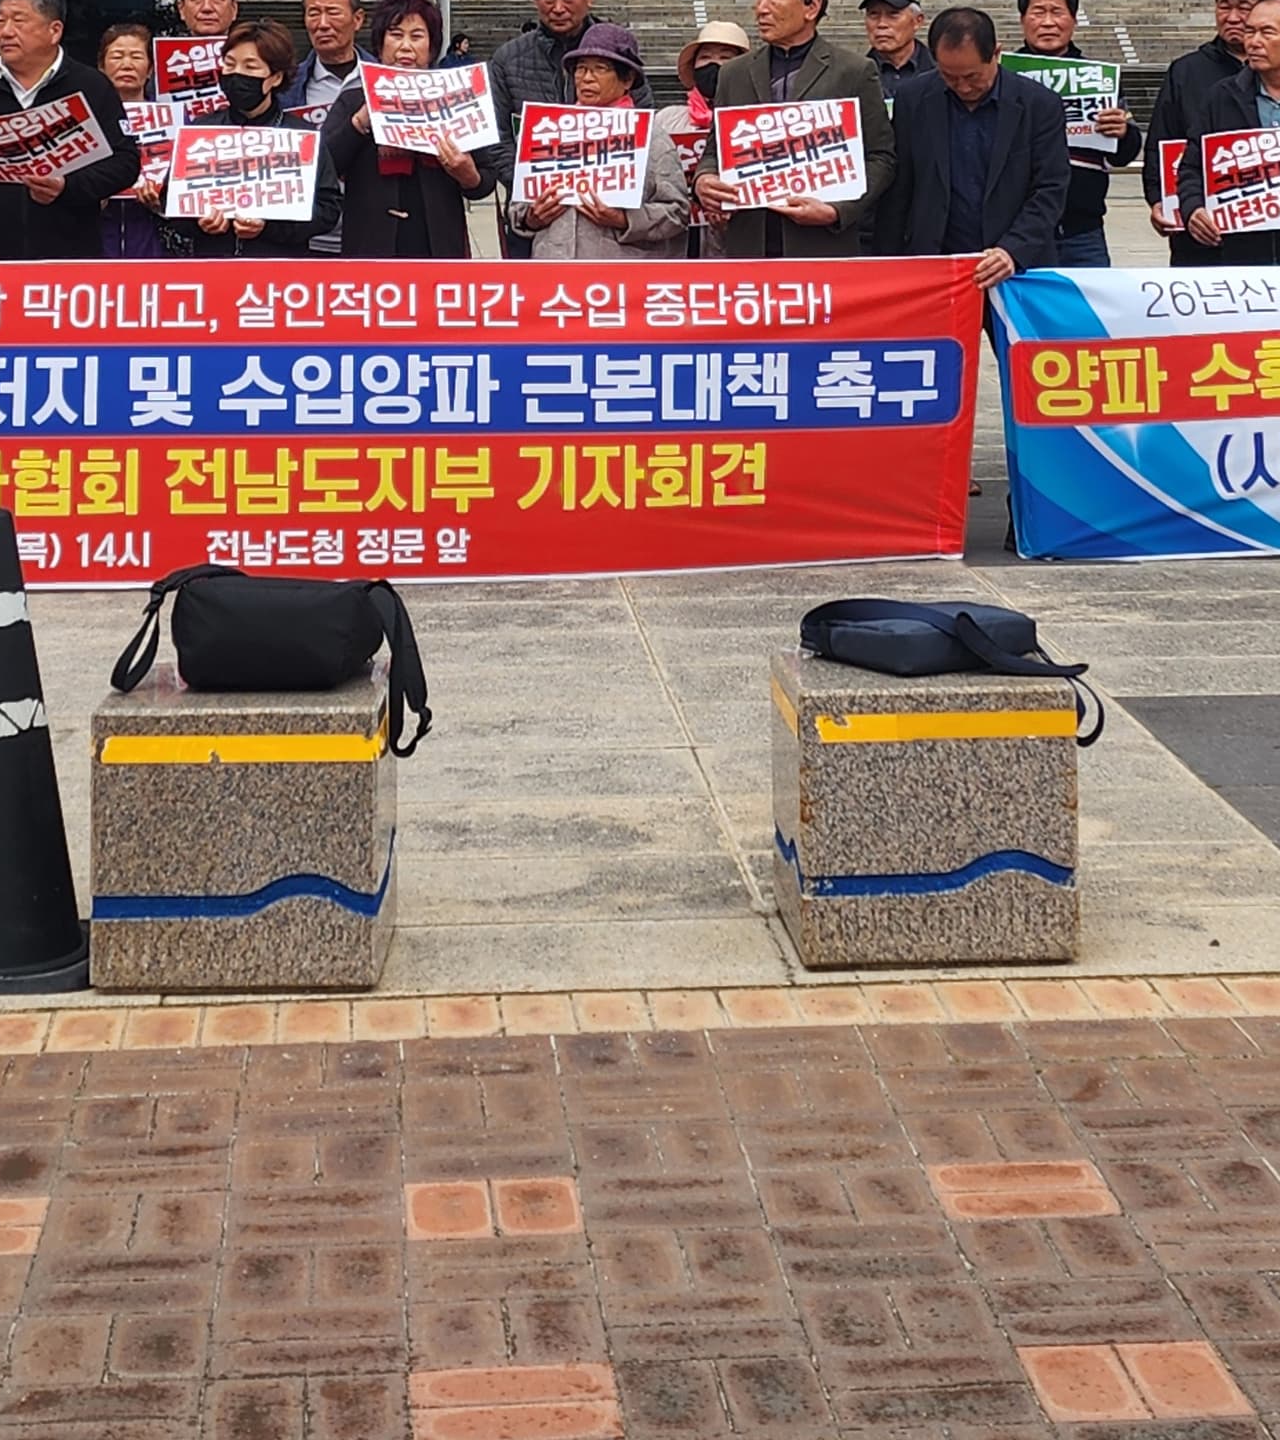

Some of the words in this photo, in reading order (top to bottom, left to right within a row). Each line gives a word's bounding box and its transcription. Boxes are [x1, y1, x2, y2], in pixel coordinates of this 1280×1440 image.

[374, 68, 473, 100] 수입양파
[186, 131, 304, 164] 수입양파
[532, 110, 639, 145] 수입양파
[730, 102, 843, 149] 수입양파
[178, 179, 305, 215] 마련하라!
[733, 154, 857, 206] 마련하라!
[23, 283, 218, 333] 막아내고,
[235, 283, 419, 329] 살인적인
[435, 282, 524, 329] 민간
[539, 283, 627, 328] 수입
[644, 282, 832, 326] 중단하라!
[1140, 278, 1279, 319] 26년산
[128, 356, 193, 426] 및
[219, 354, 499, 424] 수입양파
[523, 351, 789, 421] 근본대책
[813, 349, 940, 419] 촉구
[1032, 347, 1167, 419] 양파
[163, 445, 494, 515] 전남도지부
[517, 443, 767, 512] 기자회견
[75, 532, 150, 568] 14시
[207, 530, 345, 565] 전남도청
[356, 529, 427, 564] 정문
[435, 528, 470, 563] 앞
